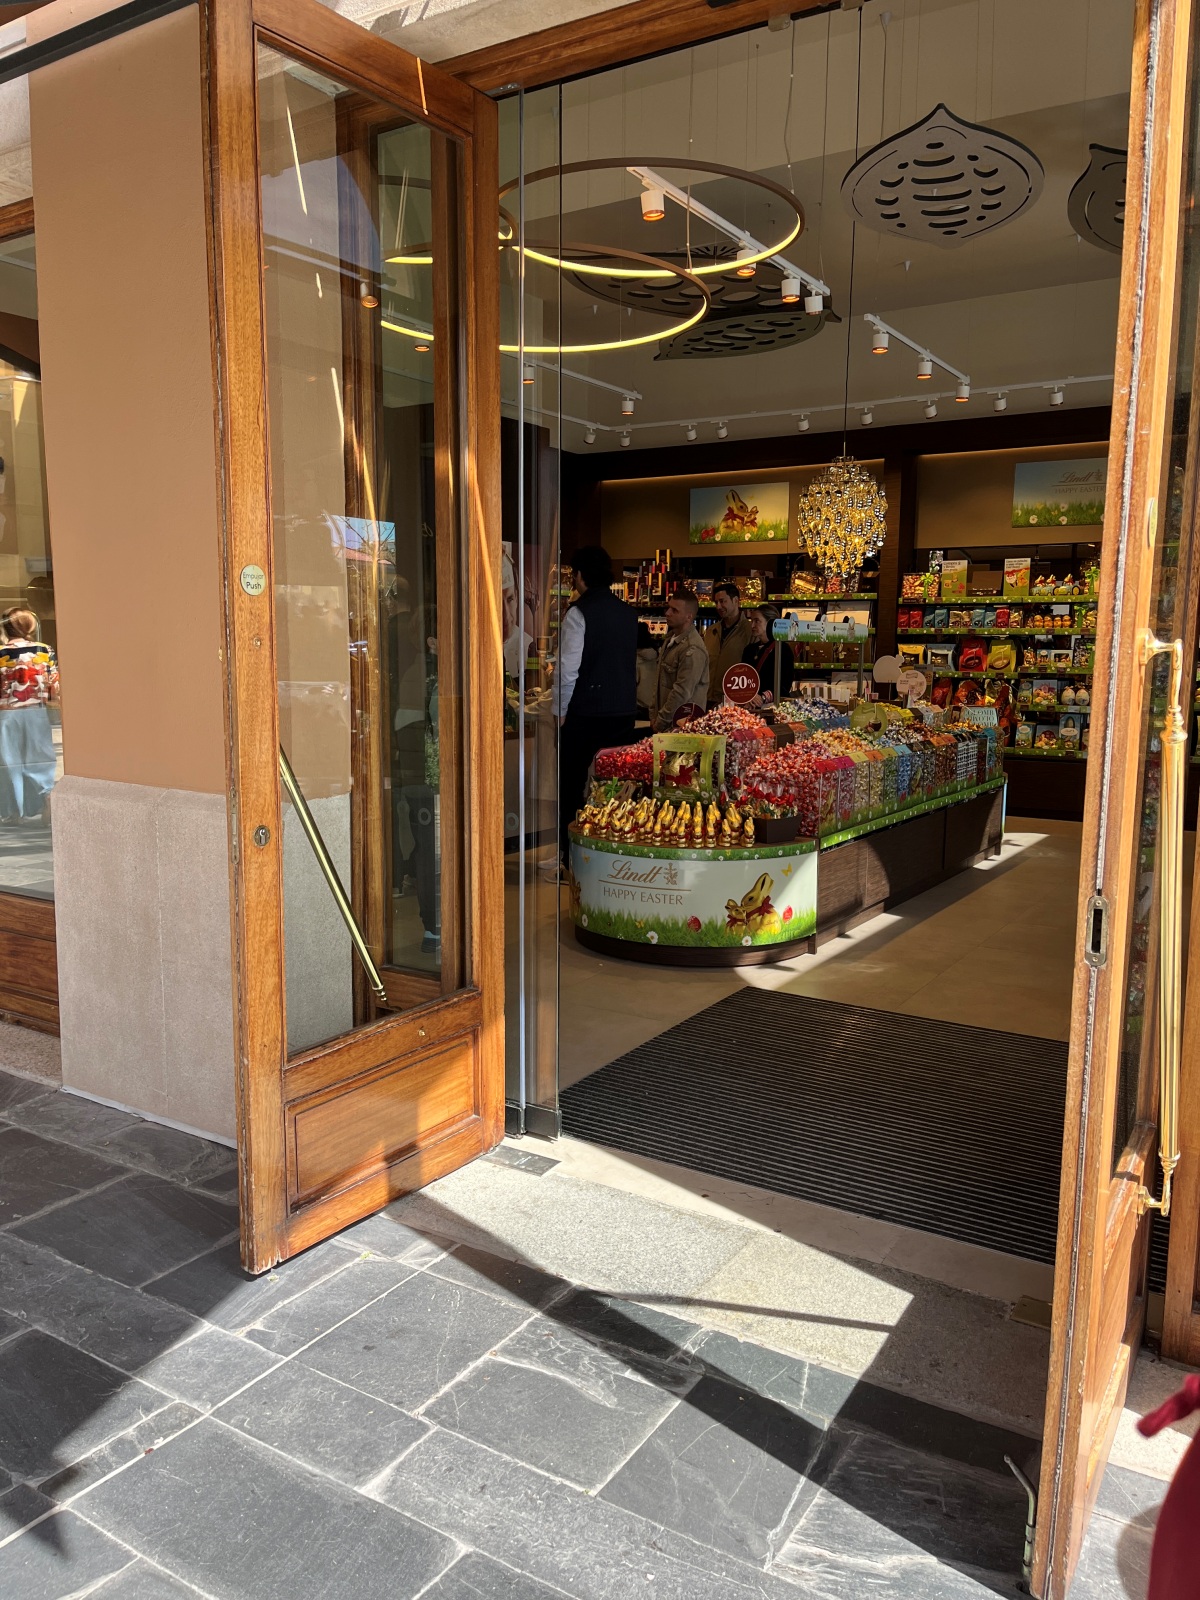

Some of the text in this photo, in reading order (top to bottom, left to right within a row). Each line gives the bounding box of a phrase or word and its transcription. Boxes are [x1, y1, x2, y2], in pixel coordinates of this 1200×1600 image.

[1058, 471, 1095, 483] Lindt
[1055, 486, 1078, 494] HAPPY
[243, 572, 263, 580] Empujar
[246, 582, 261, 590] Push
[726, 675, 756, 690] -20%
[606, 859, 663, 884] Lindt
[603, 886, 683, 906] HAPPY EASTER
